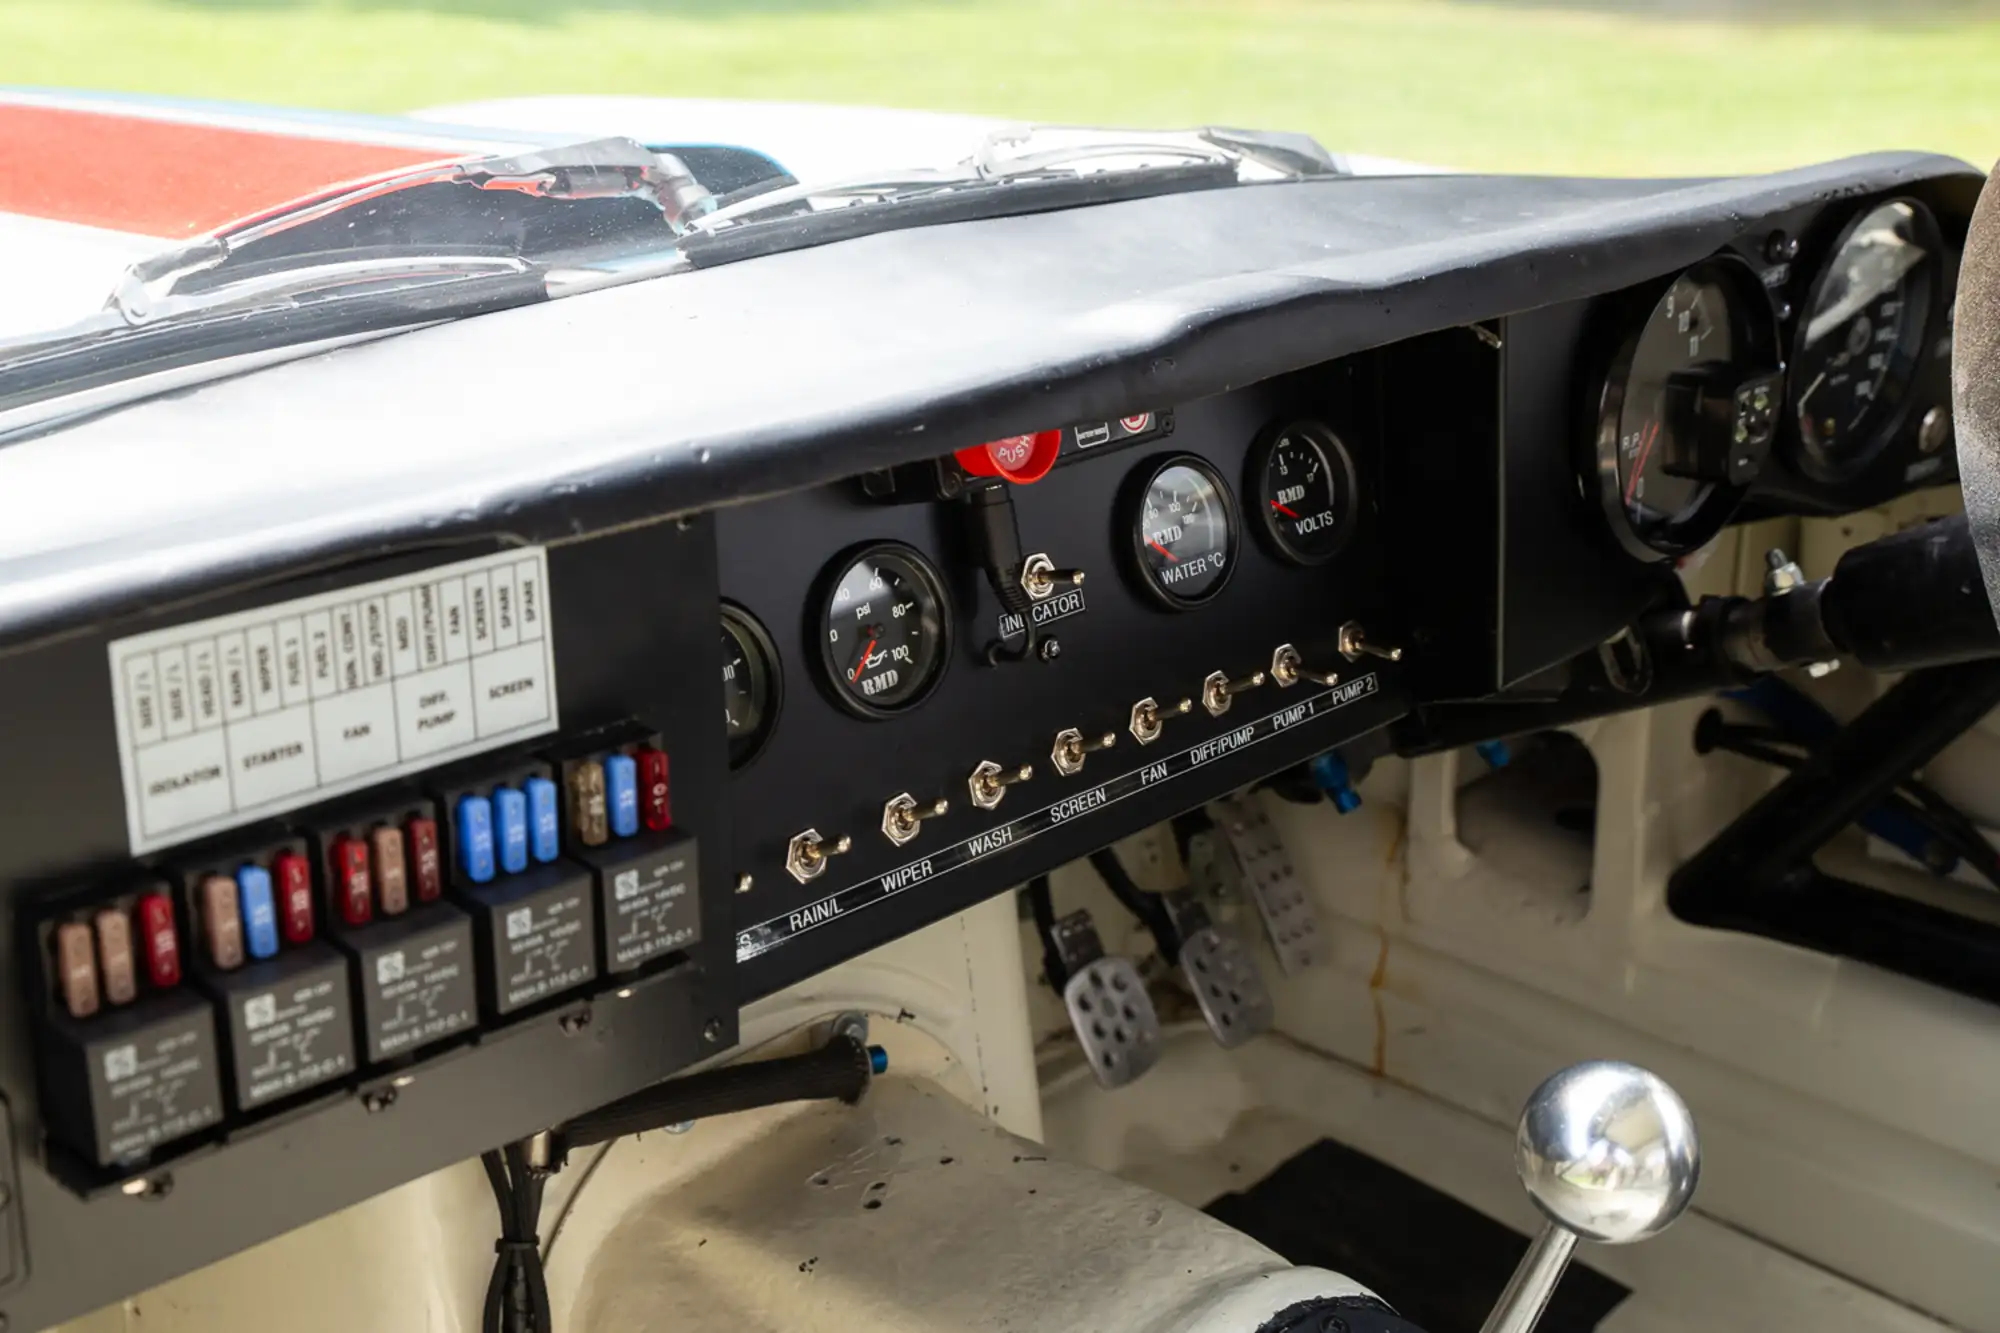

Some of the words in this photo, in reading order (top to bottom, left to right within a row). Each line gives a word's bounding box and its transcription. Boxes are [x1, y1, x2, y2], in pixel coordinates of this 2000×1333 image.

[999, 435, 1031, 464] PUSH
[1277, 485, 1305, 505] RMD
[1295, 510, 1334, 535] VOLTS
[869, 576, 883, 591] 60
[1161, 558, 1207, 585] WATER
[855, 602, 871, 620] psi
[892, 603, 905, 618] 80
[1004, 593, 1080, 632] INCATOR
[892, 645, 909, 661] 100
[488, 677, 534, 700] SCREEN
[861, 669, 899, 696] RMD
[789, 898, 844, 932] RAIN/L
[881, 859, 934, 893] WIPER
[968, 826, 1013, 857] WASH
[1050, 787, 1107, 823] SCREEN
[1140, 762, 1168, 785] FAN
[1189, 726, 1255, 765] DIFF/PUMP
[1272, 705, 1306, 730] PUMP
[1308, 701, 1315, 715] 1
[1331, 683, 1363, 705] PUMP
[1366, 676, 1374, 691] 2
